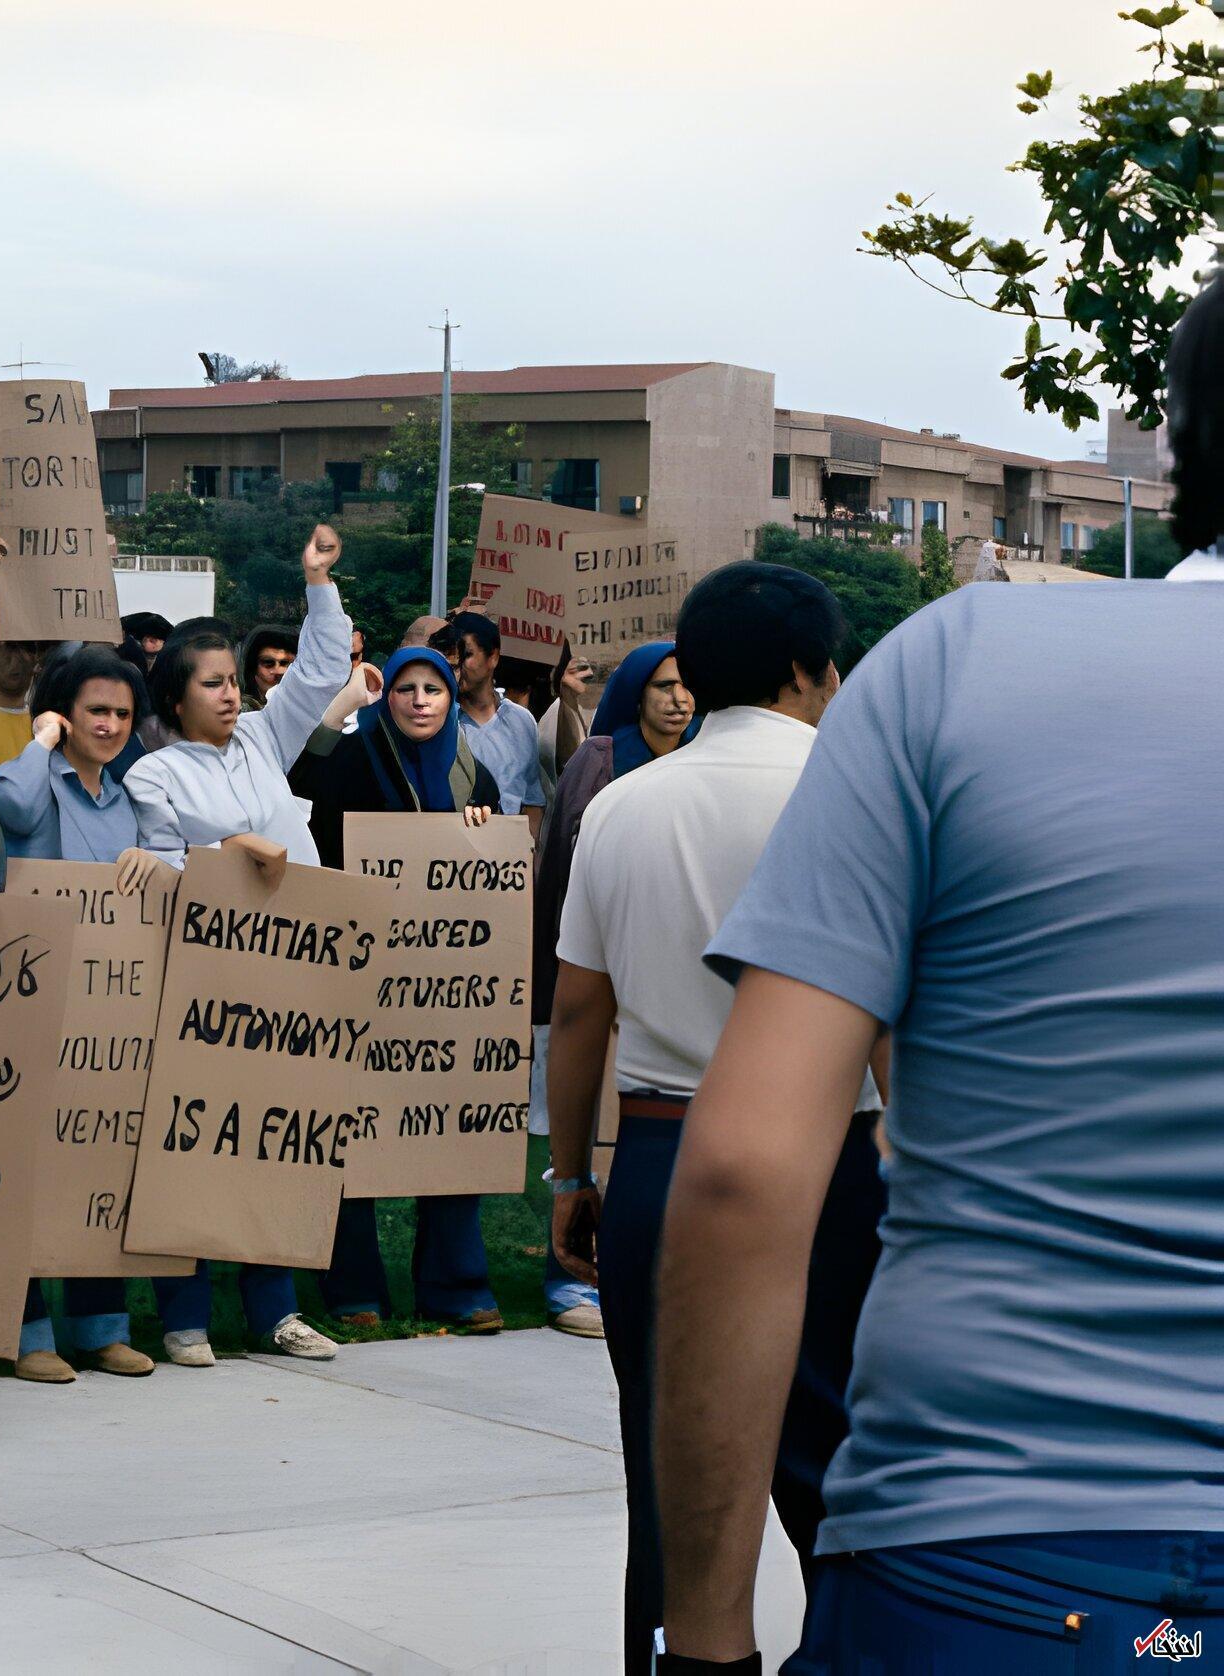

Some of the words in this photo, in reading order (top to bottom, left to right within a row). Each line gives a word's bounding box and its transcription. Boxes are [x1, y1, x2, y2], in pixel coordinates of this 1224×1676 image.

[183, 901, 376, 971] BAKHTIAR'S
[83, 959, 144, 996] THE
[179, 998, 371, 1063] AUTONOMY
[163, 1095, 206, 1152] IS
[213, 1102, 240, 1156] A
[257, 1106, 346, 1168] FAKE
